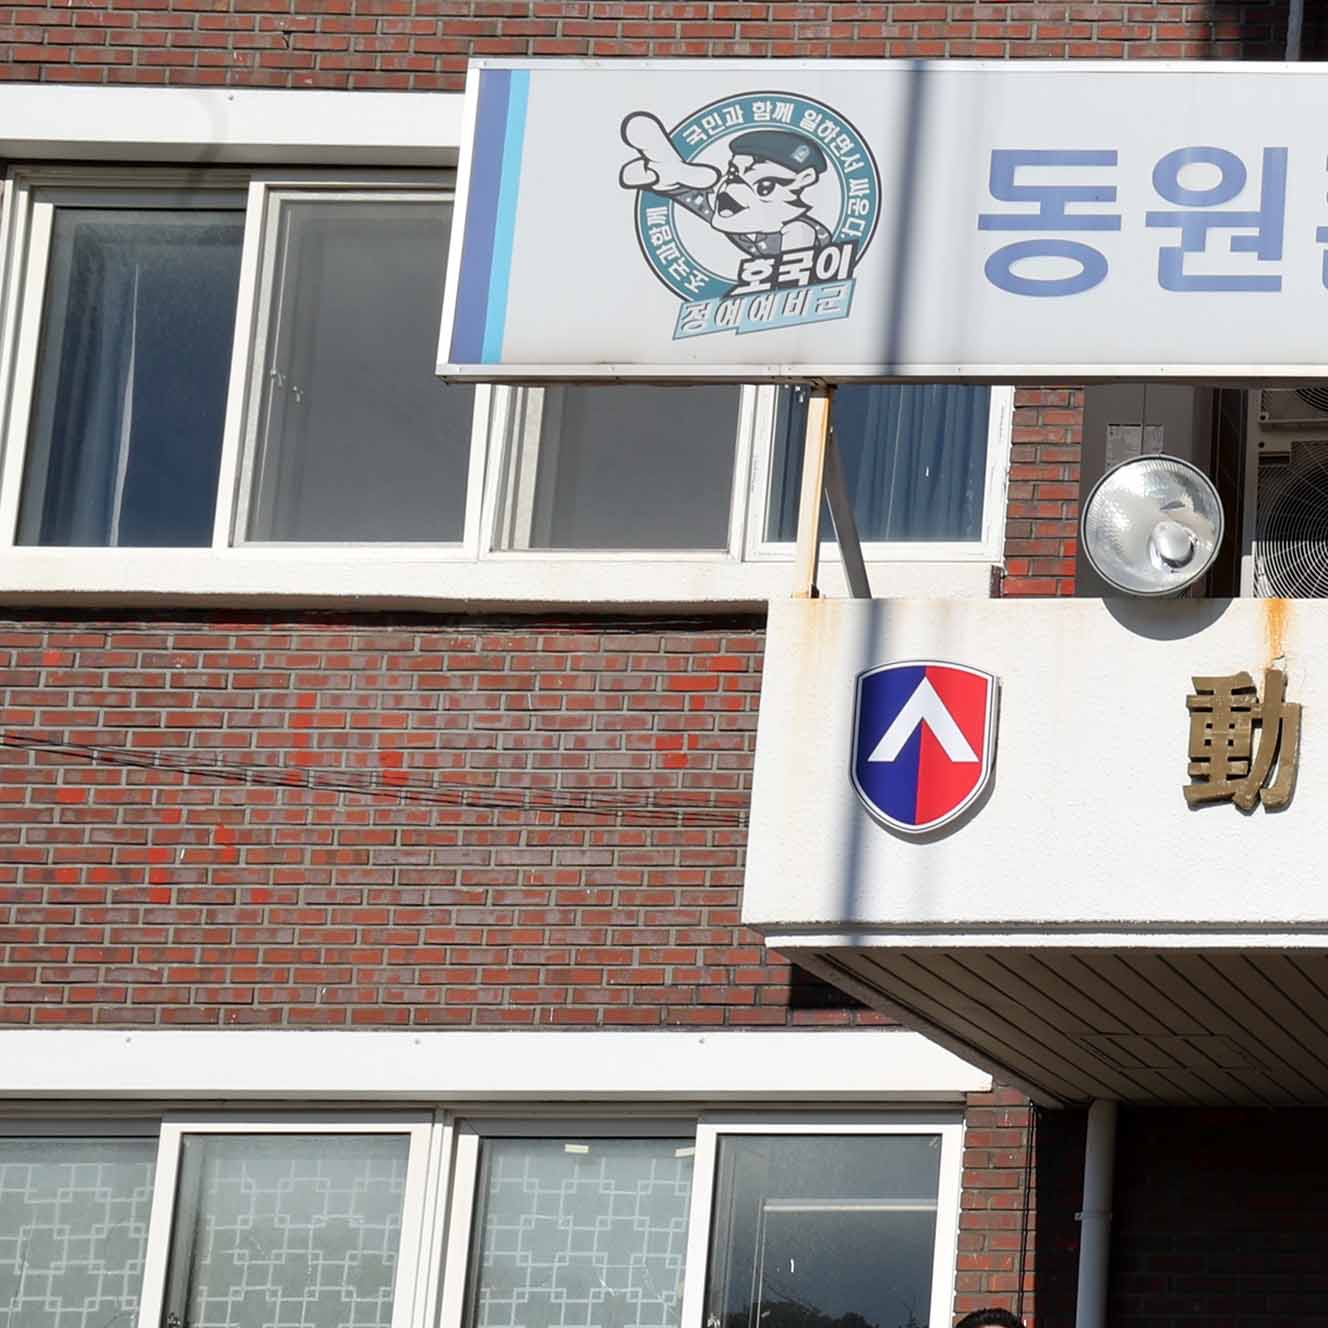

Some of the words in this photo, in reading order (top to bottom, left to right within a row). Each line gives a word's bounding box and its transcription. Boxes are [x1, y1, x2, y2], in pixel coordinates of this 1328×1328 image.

[681, 104, 745, 147] 국민과
[751, 100, 795, 124] 함께
[799, 108, 866, 174] 일하면서
[731, 243, 854, 297] 호국이
